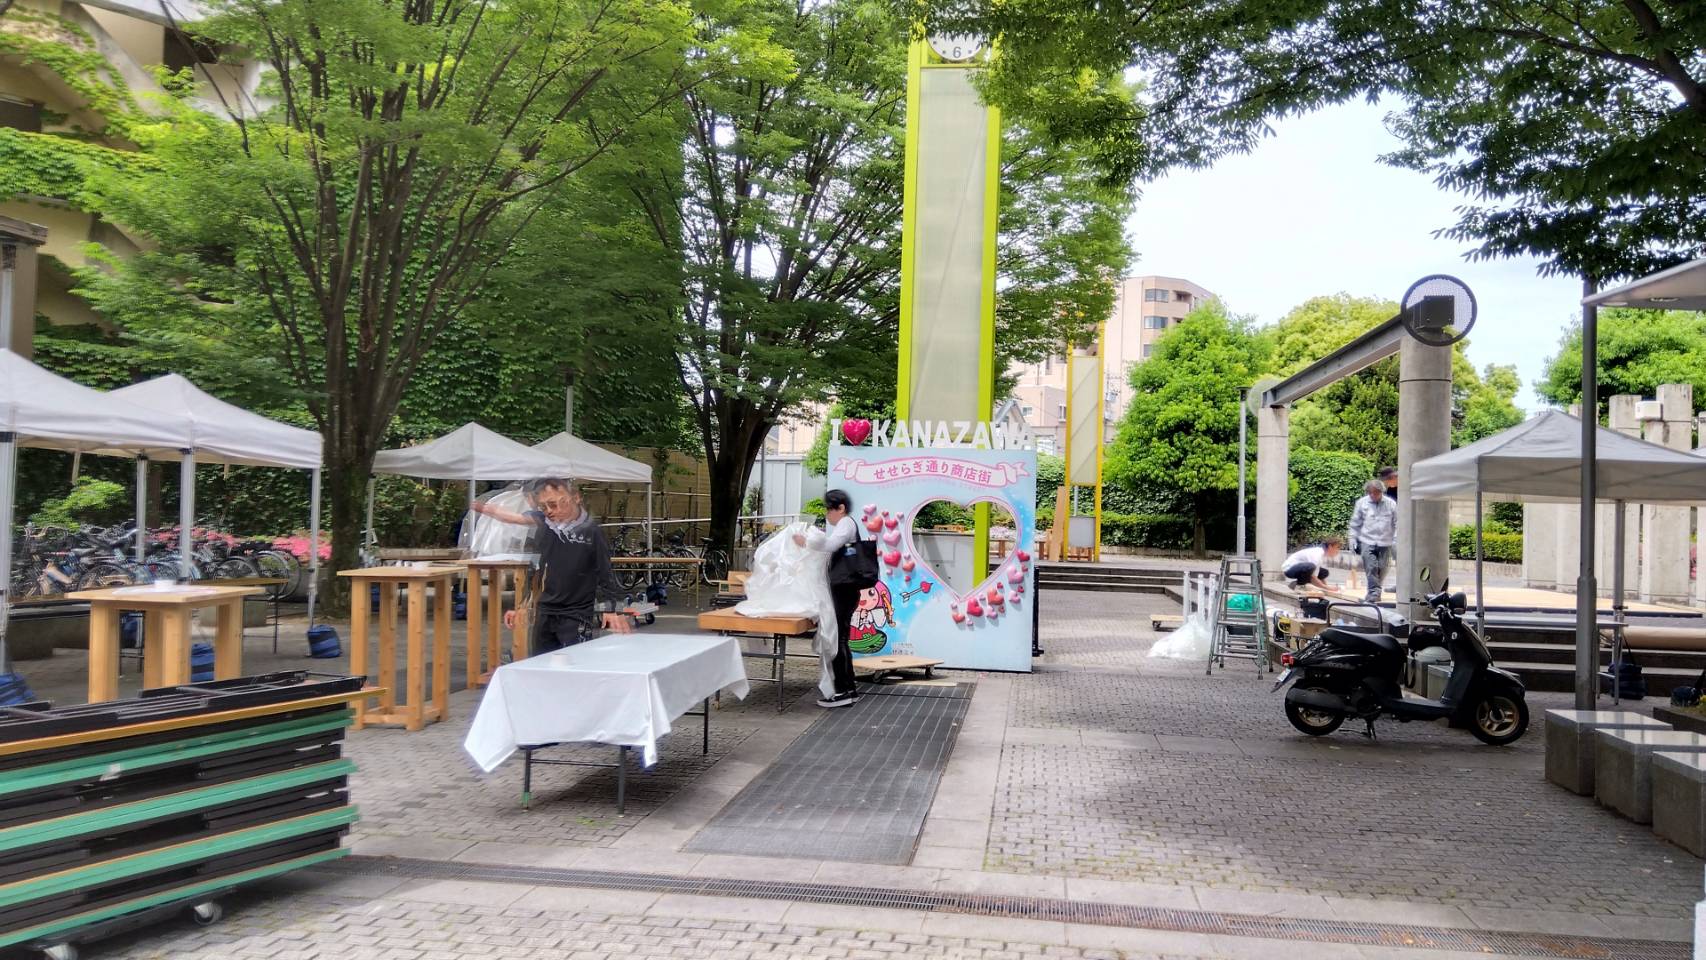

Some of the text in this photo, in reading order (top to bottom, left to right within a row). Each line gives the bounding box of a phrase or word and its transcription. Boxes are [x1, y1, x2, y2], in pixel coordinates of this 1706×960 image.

[952, 46, 962, 58] 6
[830, 419, 842, 446] I
[874, 460, 992, 484] せせらぎ通り商店街
